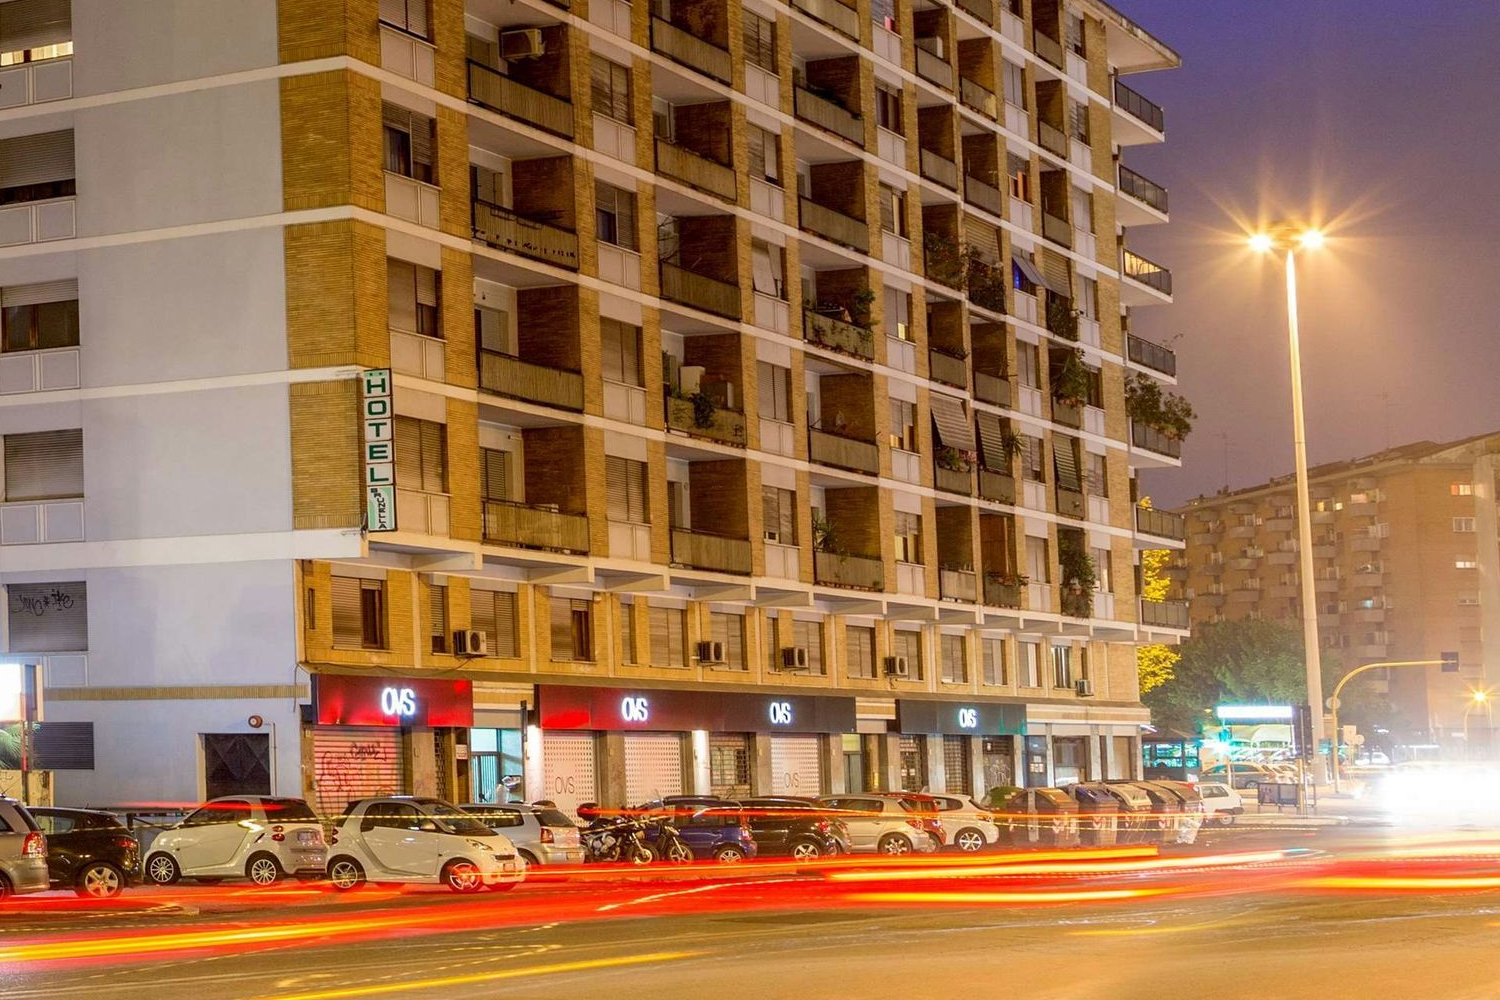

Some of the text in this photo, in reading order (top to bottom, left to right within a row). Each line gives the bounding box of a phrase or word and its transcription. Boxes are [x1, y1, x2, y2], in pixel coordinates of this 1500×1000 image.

[366, 378, 389, 483] HOTEL
[381, 687, 416, 715] OVS
[621, 697, 649, 721] OVS
[769, 702, 792, 723] OVS
[555, 776, 575, 794] OVS
